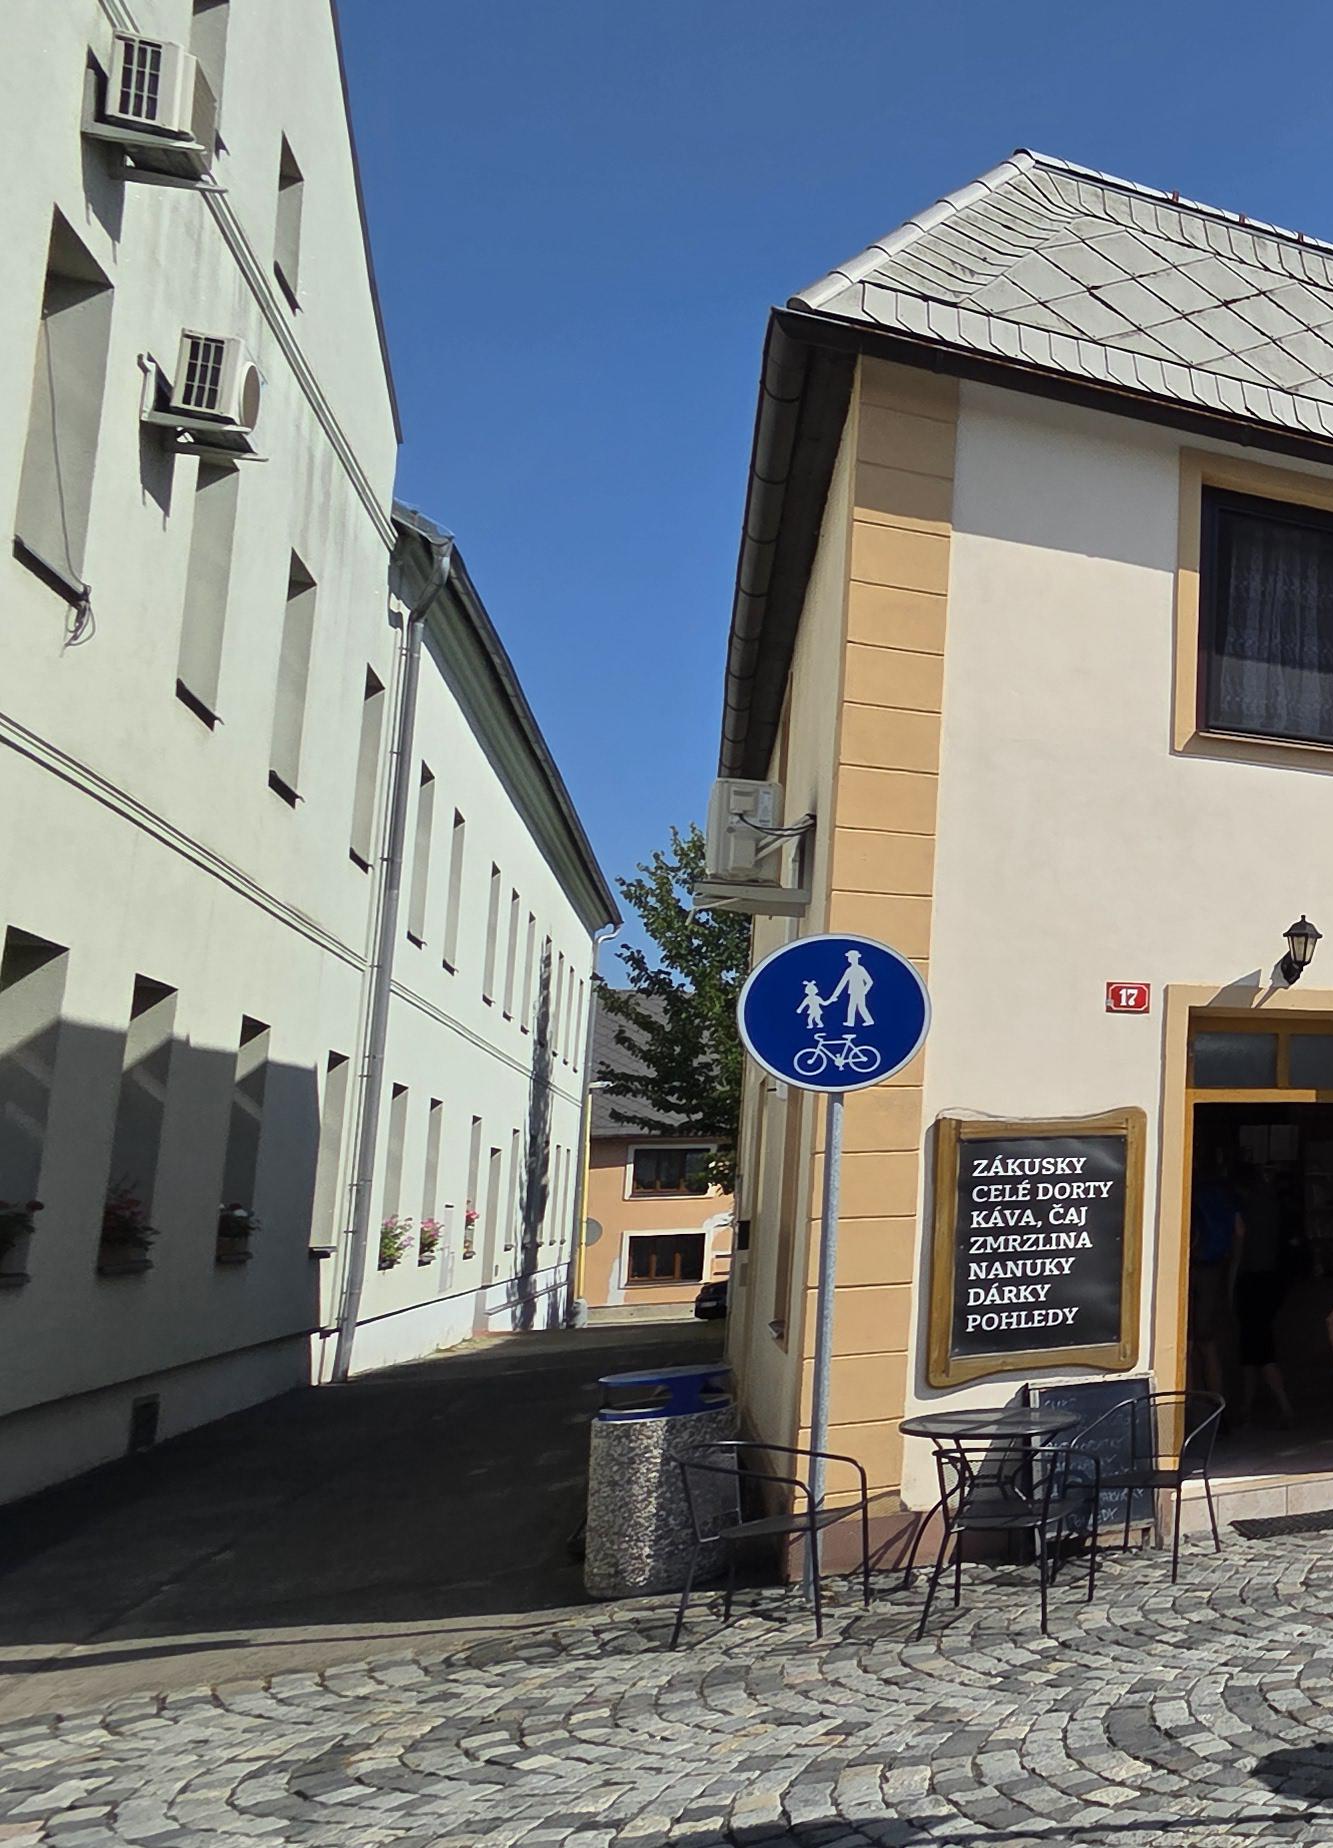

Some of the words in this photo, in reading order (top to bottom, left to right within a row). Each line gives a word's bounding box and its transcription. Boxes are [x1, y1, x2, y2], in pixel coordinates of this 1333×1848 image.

[1119, 988, 1138, 1006] 17
[972, 1155, 1087, 1176] ZÁKUSKY
[972, 1180, 1031, 1202] CELÉ
[1036, 1181, 1113, 1200] DORTY
[970, 1206, 1042, 1228] KÁVA,
[1049, 1204, 1088, 1226] ČAJ
[969, 1231, 1093, 1254] ZMRZLINA
[968, 1257, 1075, 1280] NANUKY
[967, 1283, 1051, 1306] DÁRKY
[966, 1308, 1079, 1332] POHLEDY
